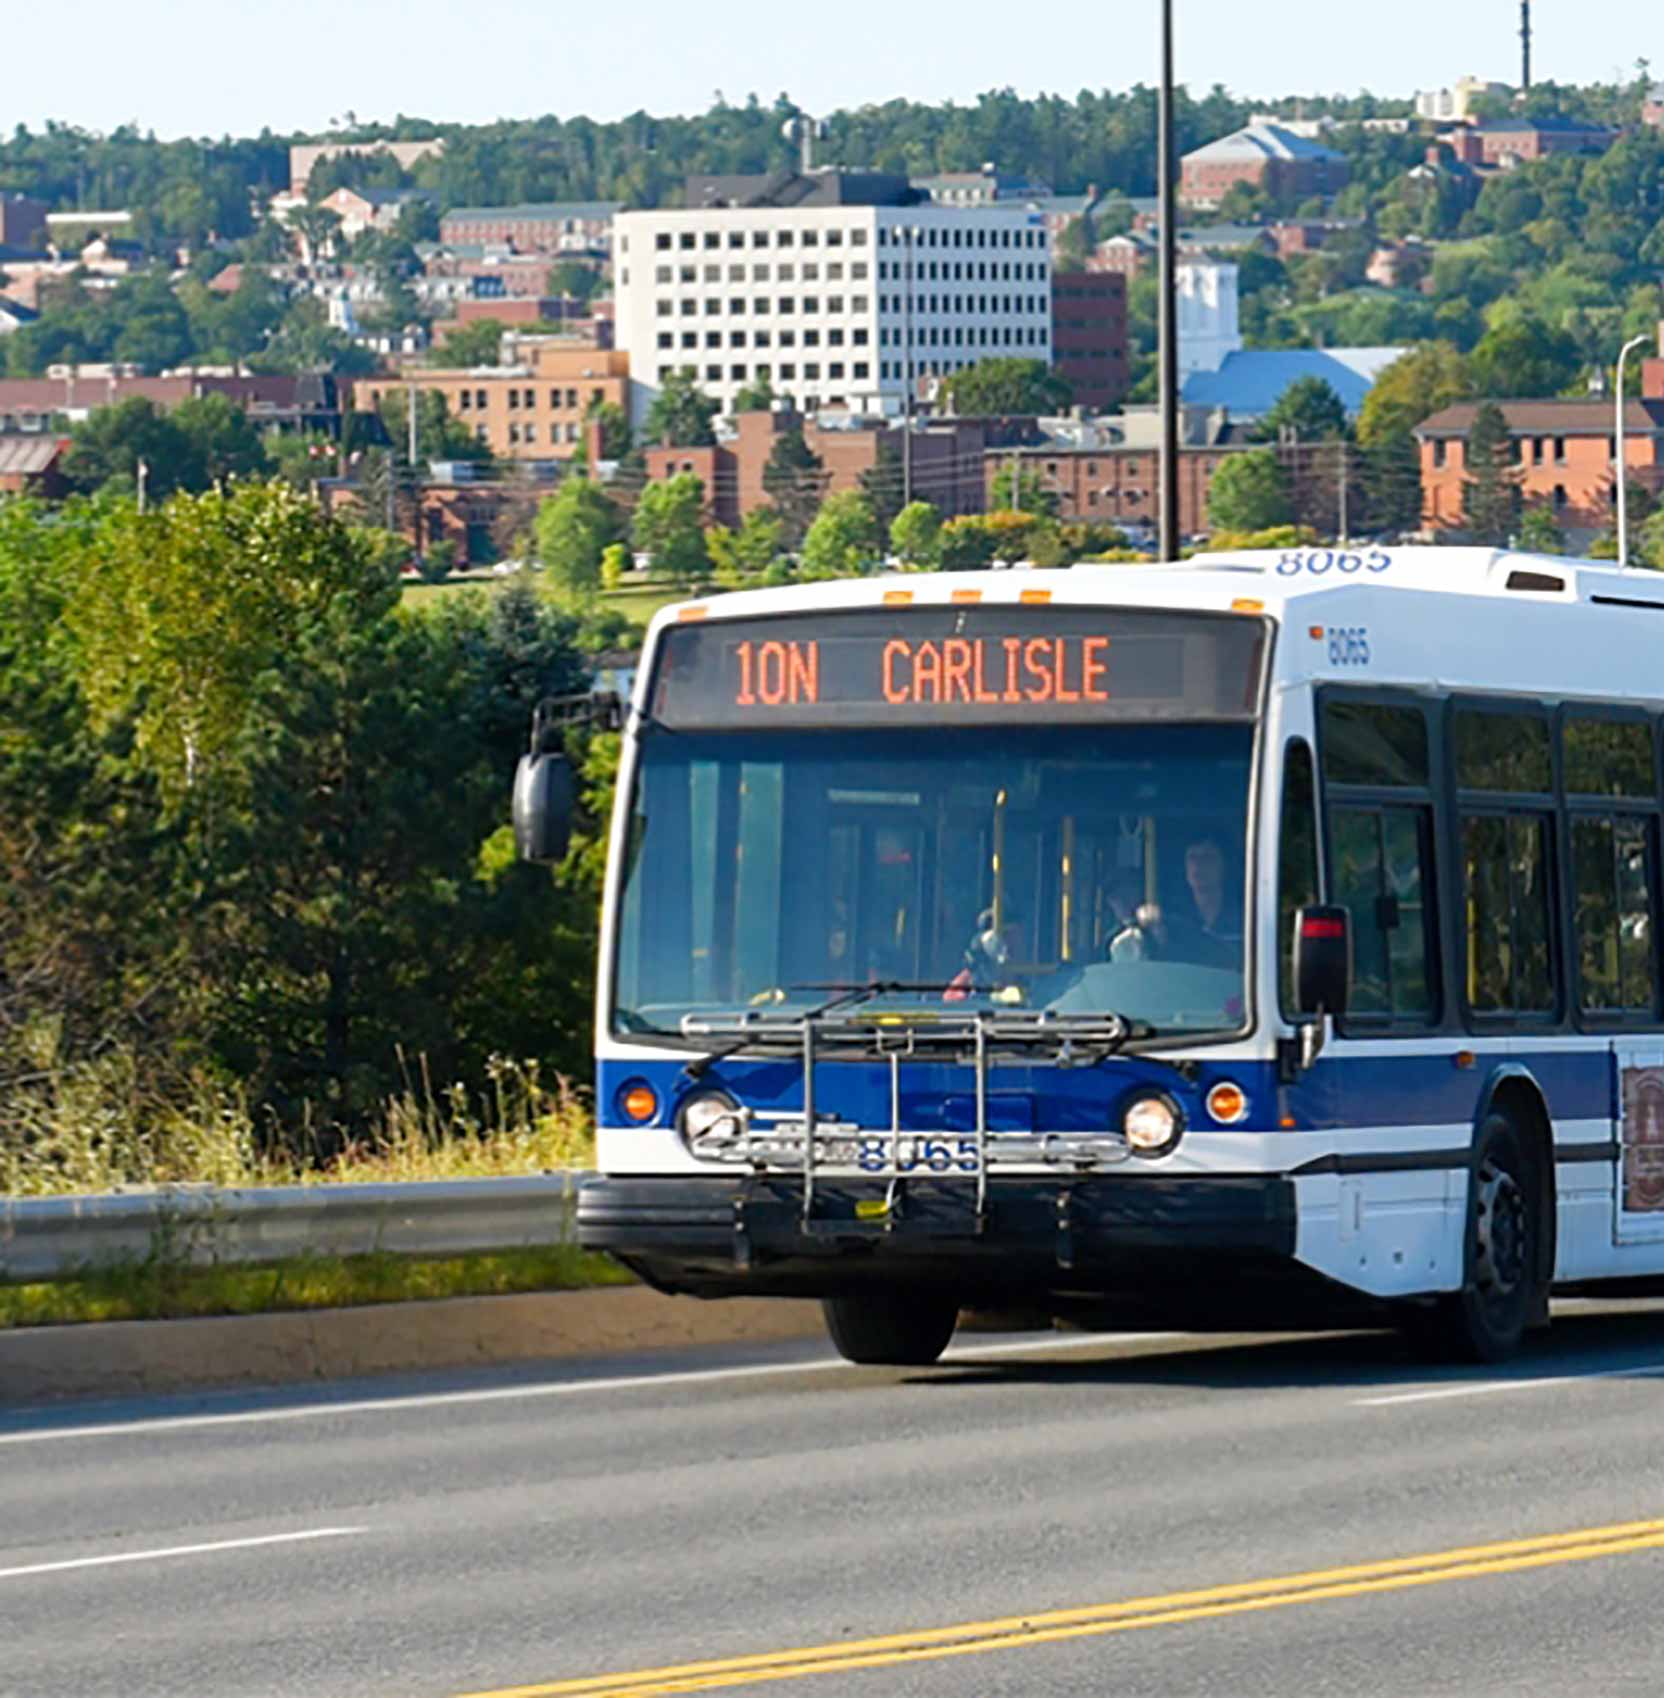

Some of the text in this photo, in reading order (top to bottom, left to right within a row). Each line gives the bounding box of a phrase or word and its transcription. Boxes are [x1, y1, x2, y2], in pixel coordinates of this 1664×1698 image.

[1276, 550, 1391, 576] 8065
[736, 637, 1109, 704] 10N CARLISLE
[858, 1135, 979, 1171] 8065
